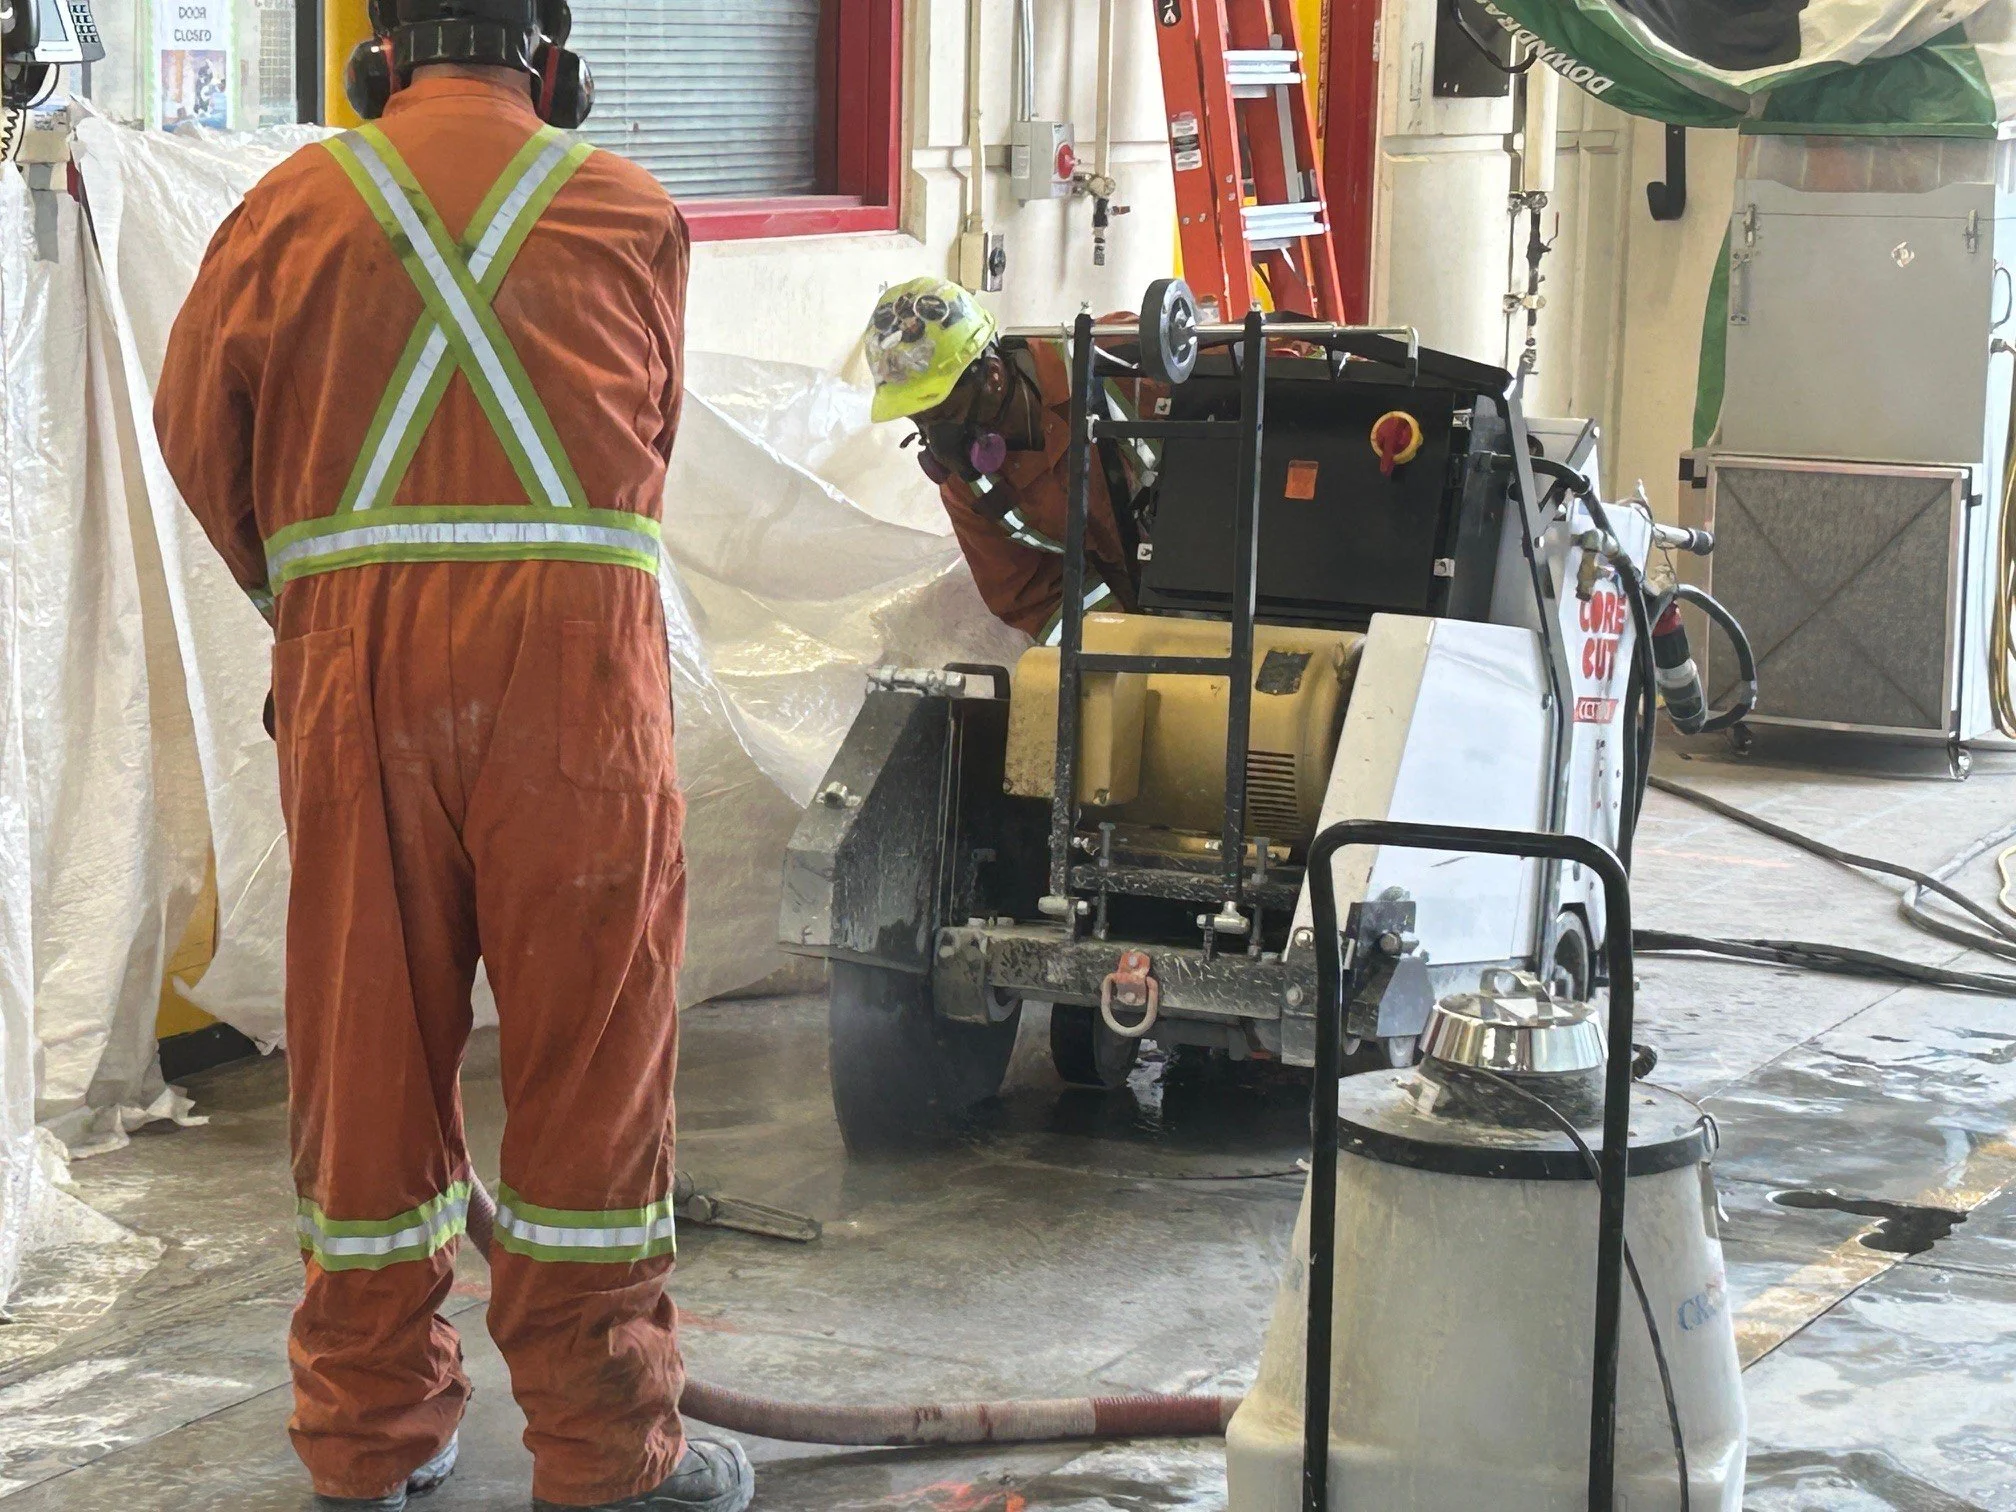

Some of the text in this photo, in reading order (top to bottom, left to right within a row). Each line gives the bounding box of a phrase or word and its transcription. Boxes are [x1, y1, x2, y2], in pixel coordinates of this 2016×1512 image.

[178, 6, 207, 20] DOOR
[174, 29, 212, 42] CLOSED
[1475, 0, 1615, 95] DOWNDRA
[1579, 590, 1628, 635] CORE
[1582, 637, 1619, 681] CUT
